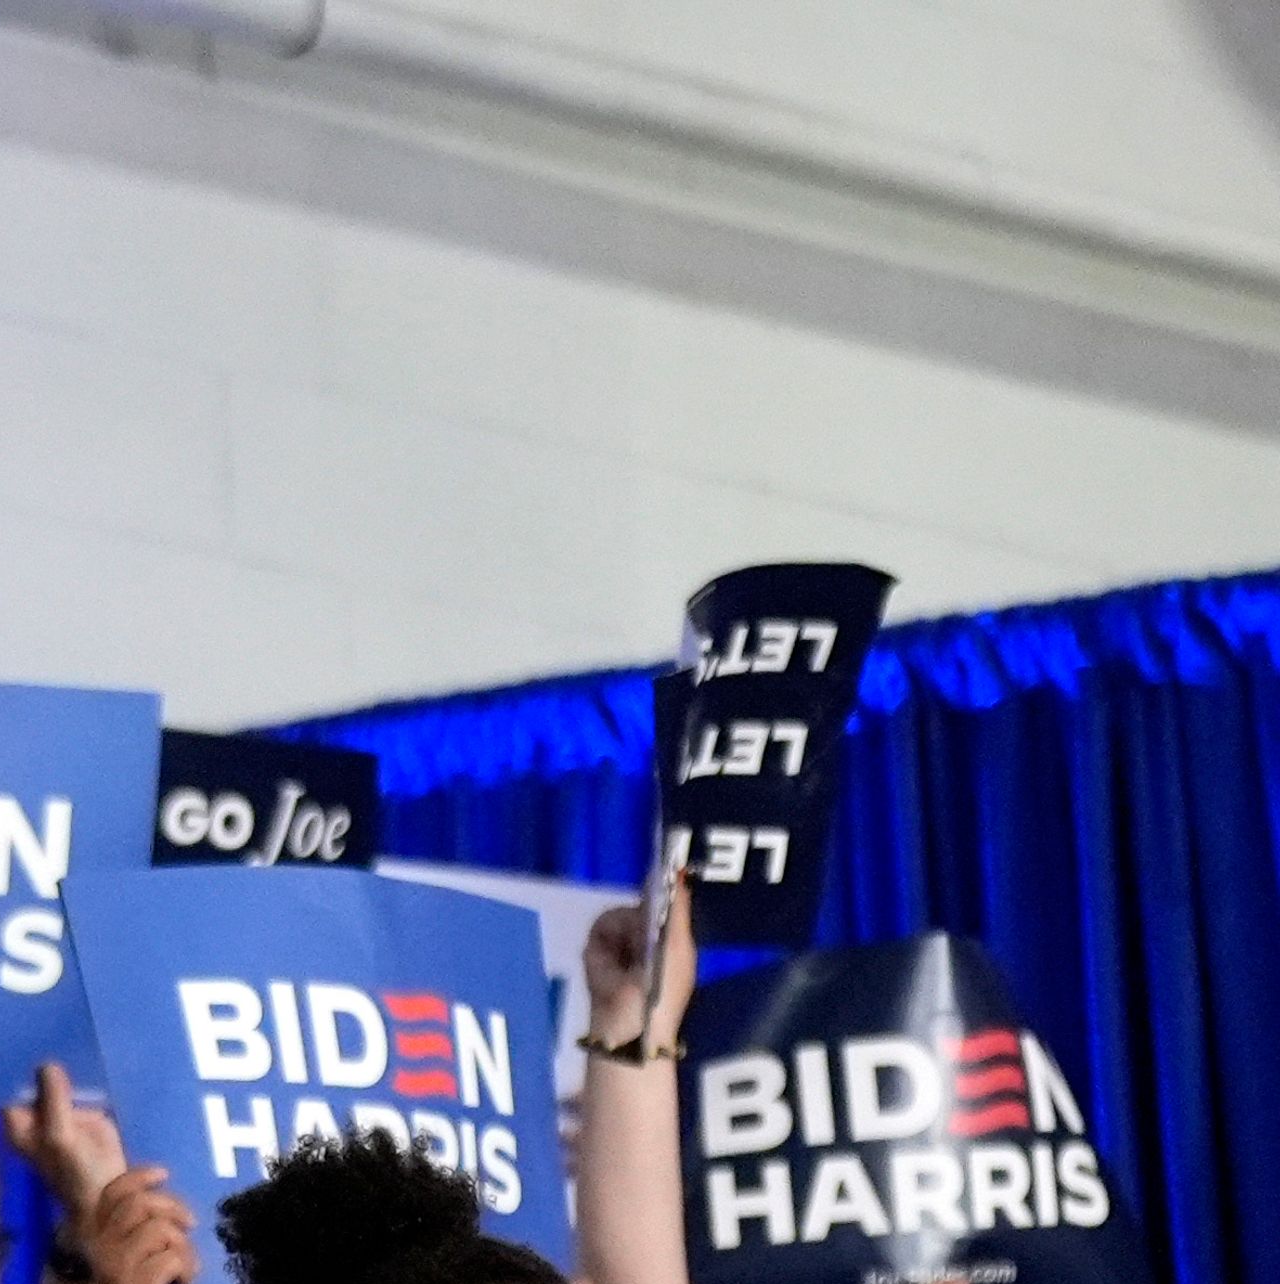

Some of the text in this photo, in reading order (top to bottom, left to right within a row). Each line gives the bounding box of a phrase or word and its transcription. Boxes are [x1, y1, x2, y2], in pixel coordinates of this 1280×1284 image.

[160, 786, 255, 851] GO
[248, 775, 351, 868] Joe
[178, 977, 515, 1116] BIDEN
[698, 1028, 1084, 1159] BIDEN
[705, 1143, 1110, 1250] HARRIS
